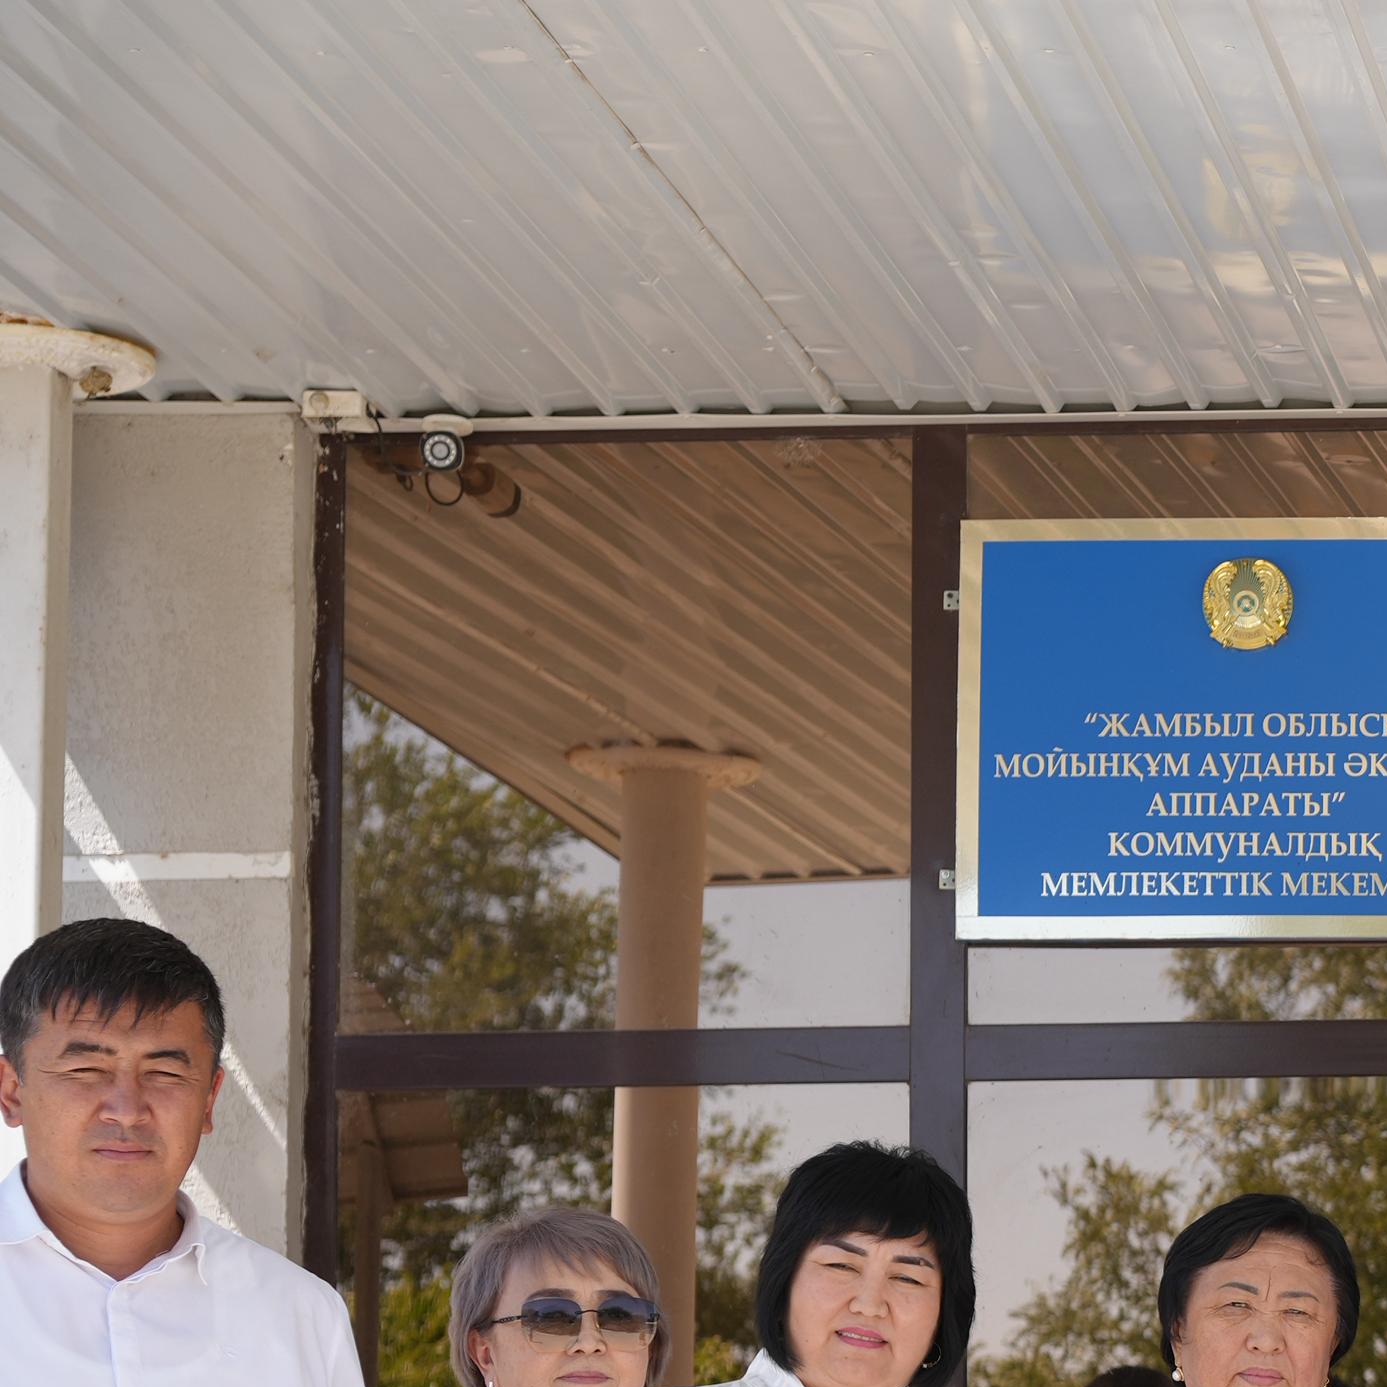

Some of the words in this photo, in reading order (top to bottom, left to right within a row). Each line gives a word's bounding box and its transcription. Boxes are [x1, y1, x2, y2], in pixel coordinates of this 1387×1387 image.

[1084, 712, 1255, 738] “ЖАМБЫЛ
[994, 746, 1191, 782] МОЙЫНҚҰМ
[1198, 752, 1336, 783] АУДАНЫ
[1145, 791, 1346, 817] АППАРАТЫ”
[1107, 831, 1383, 863] КОММУНАЛДЫҚ
[1040, 871, 1273, 897] МЕМЛЕКЕТТІК
